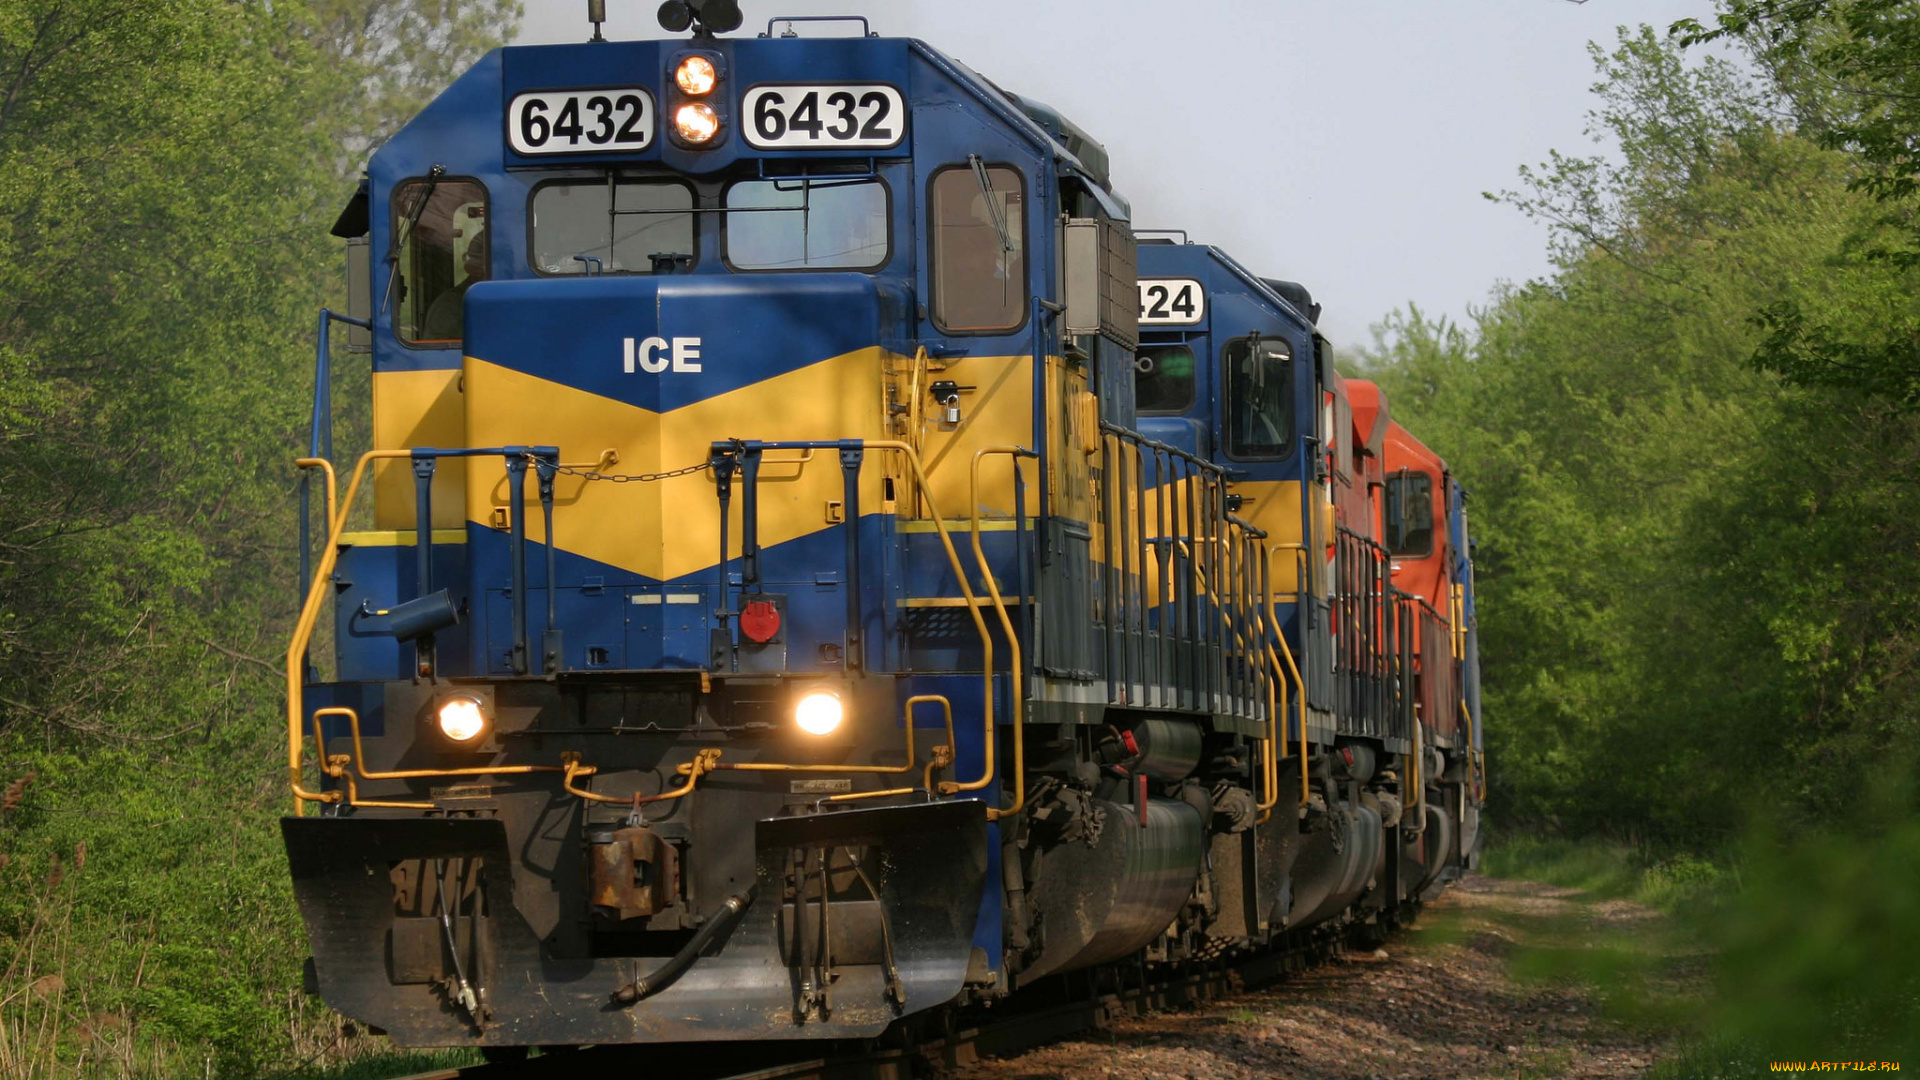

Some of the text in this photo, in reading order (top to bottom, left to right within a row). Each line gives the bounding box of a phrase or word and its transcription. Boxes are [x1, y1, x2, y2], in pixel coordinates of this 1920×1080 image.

[521, 96, 644, 147] 6432
[754, 91, 892, 141] 6432
[624, 337, 702, 373] ICE
